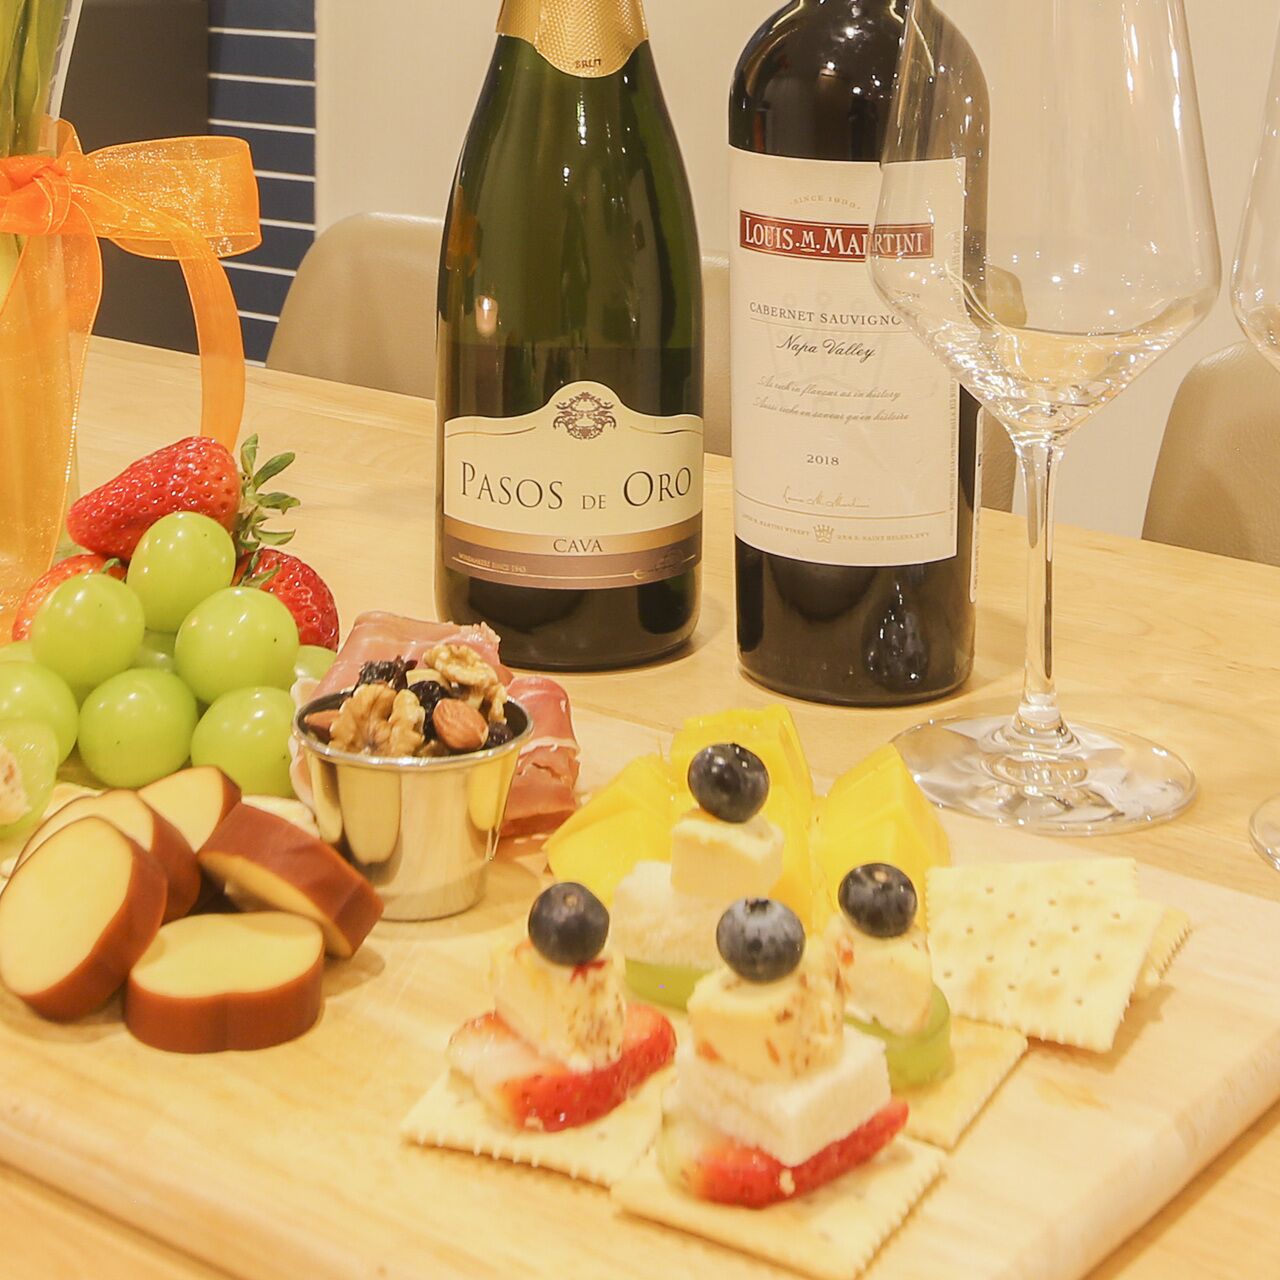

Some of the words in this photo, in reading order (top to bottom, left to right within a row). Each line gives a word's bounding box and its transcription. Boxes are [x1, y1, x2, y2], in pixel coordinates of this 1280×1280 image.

[744, 216, 793, 250] LOUIS
[821, 227, 924, 256] MARTINI
[749, 301, 815, 323] CABERNET
[820, 312, 902, 326] SAUVIGNO
[776, 334, 818, 357] Napa
[822, 338, 876, 363] Valley
[806, 453, 840, 466] 2018
[460, 460, 564, 510] PASOS
[582, 494, 606, 510] DE
[623, 466, 692, 507] ORO
[552, 538, 604, 553] CAVA
